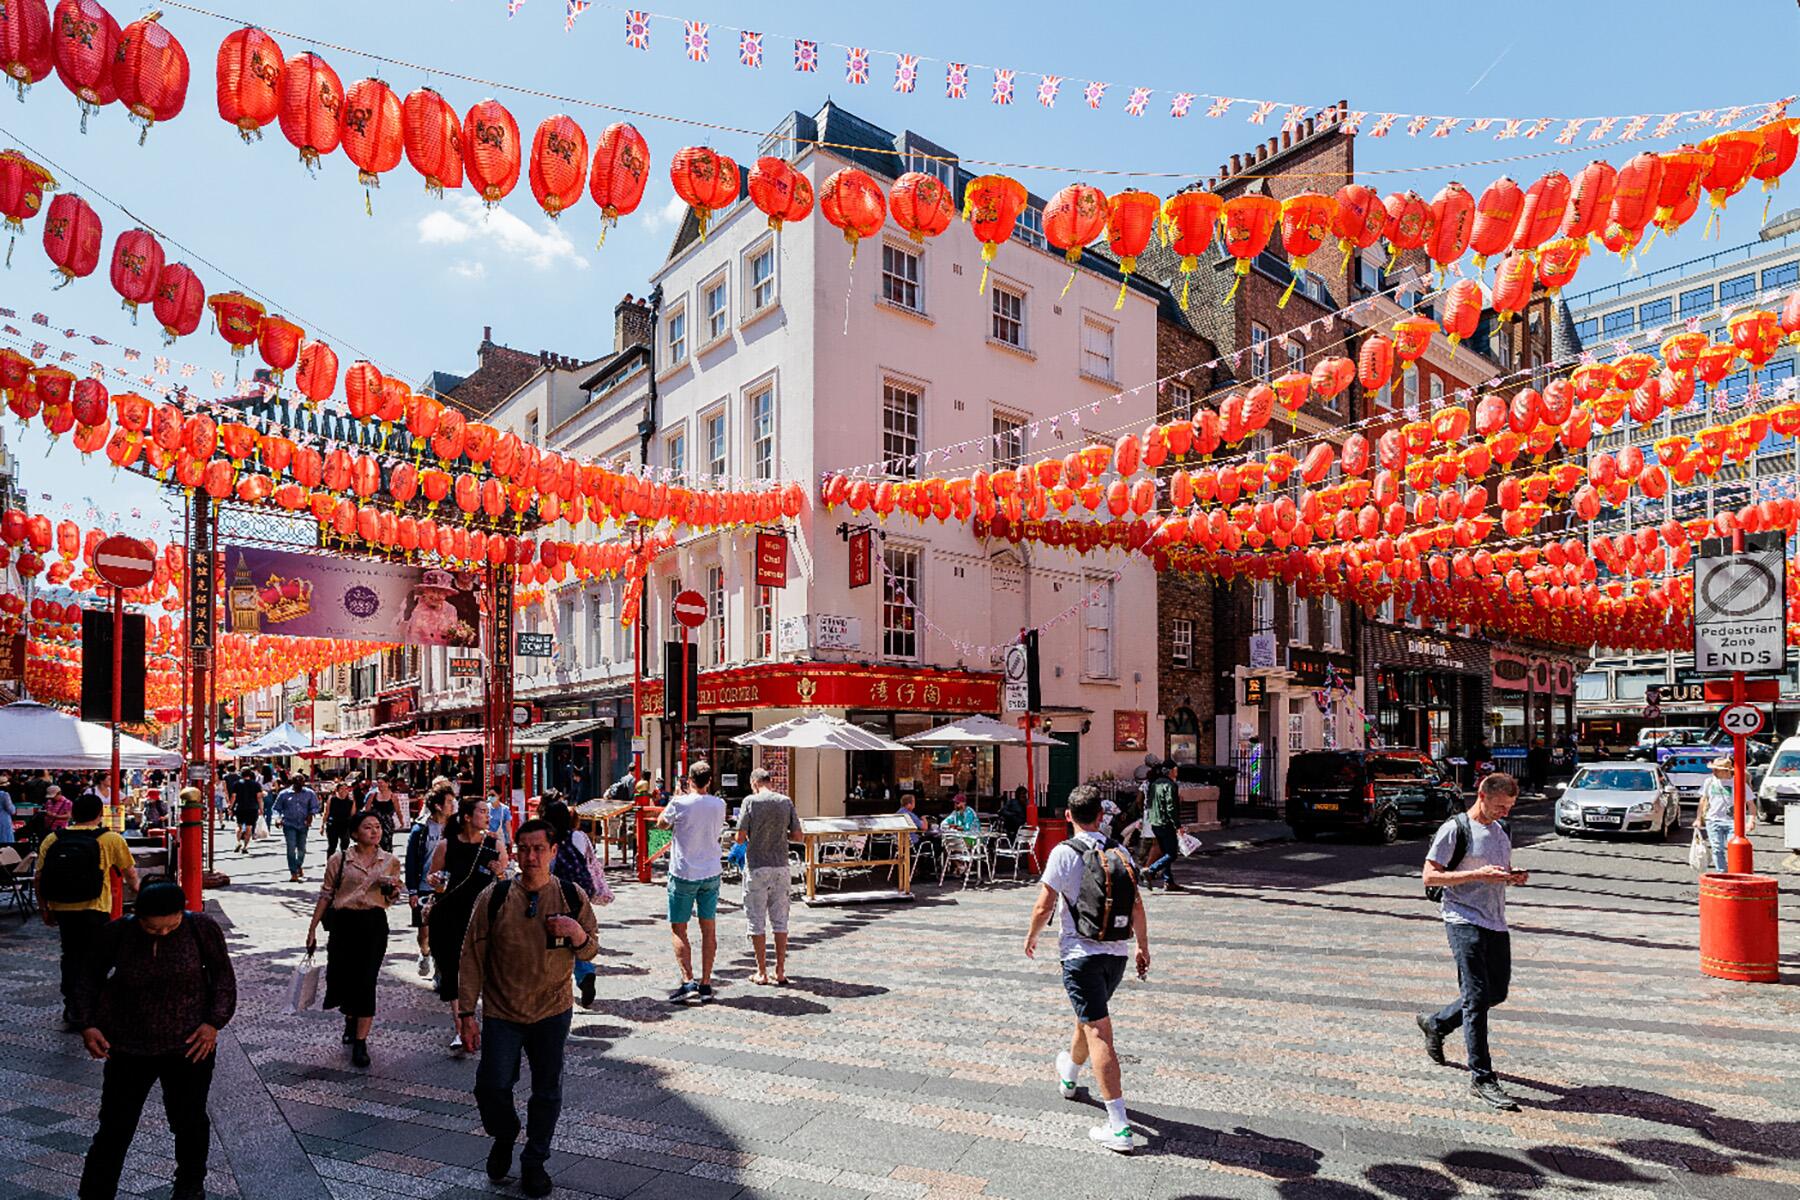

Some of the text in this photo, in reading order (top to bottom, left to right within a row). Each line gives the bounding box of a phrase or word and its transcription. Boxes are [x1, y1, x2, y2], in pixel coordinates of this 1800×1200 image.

[763, 553, 781, 564] Chai
[758, 567, 785, 579] Corner
[1701, 623, 1777, 637] Pedestrian
[1720, 636, 1756, 647] Zone
[1706, 649, 1771, 666] ENDS
[697, 685, 759, 705] HAI CORNER
[1727, 712, 1758, 728] 20
